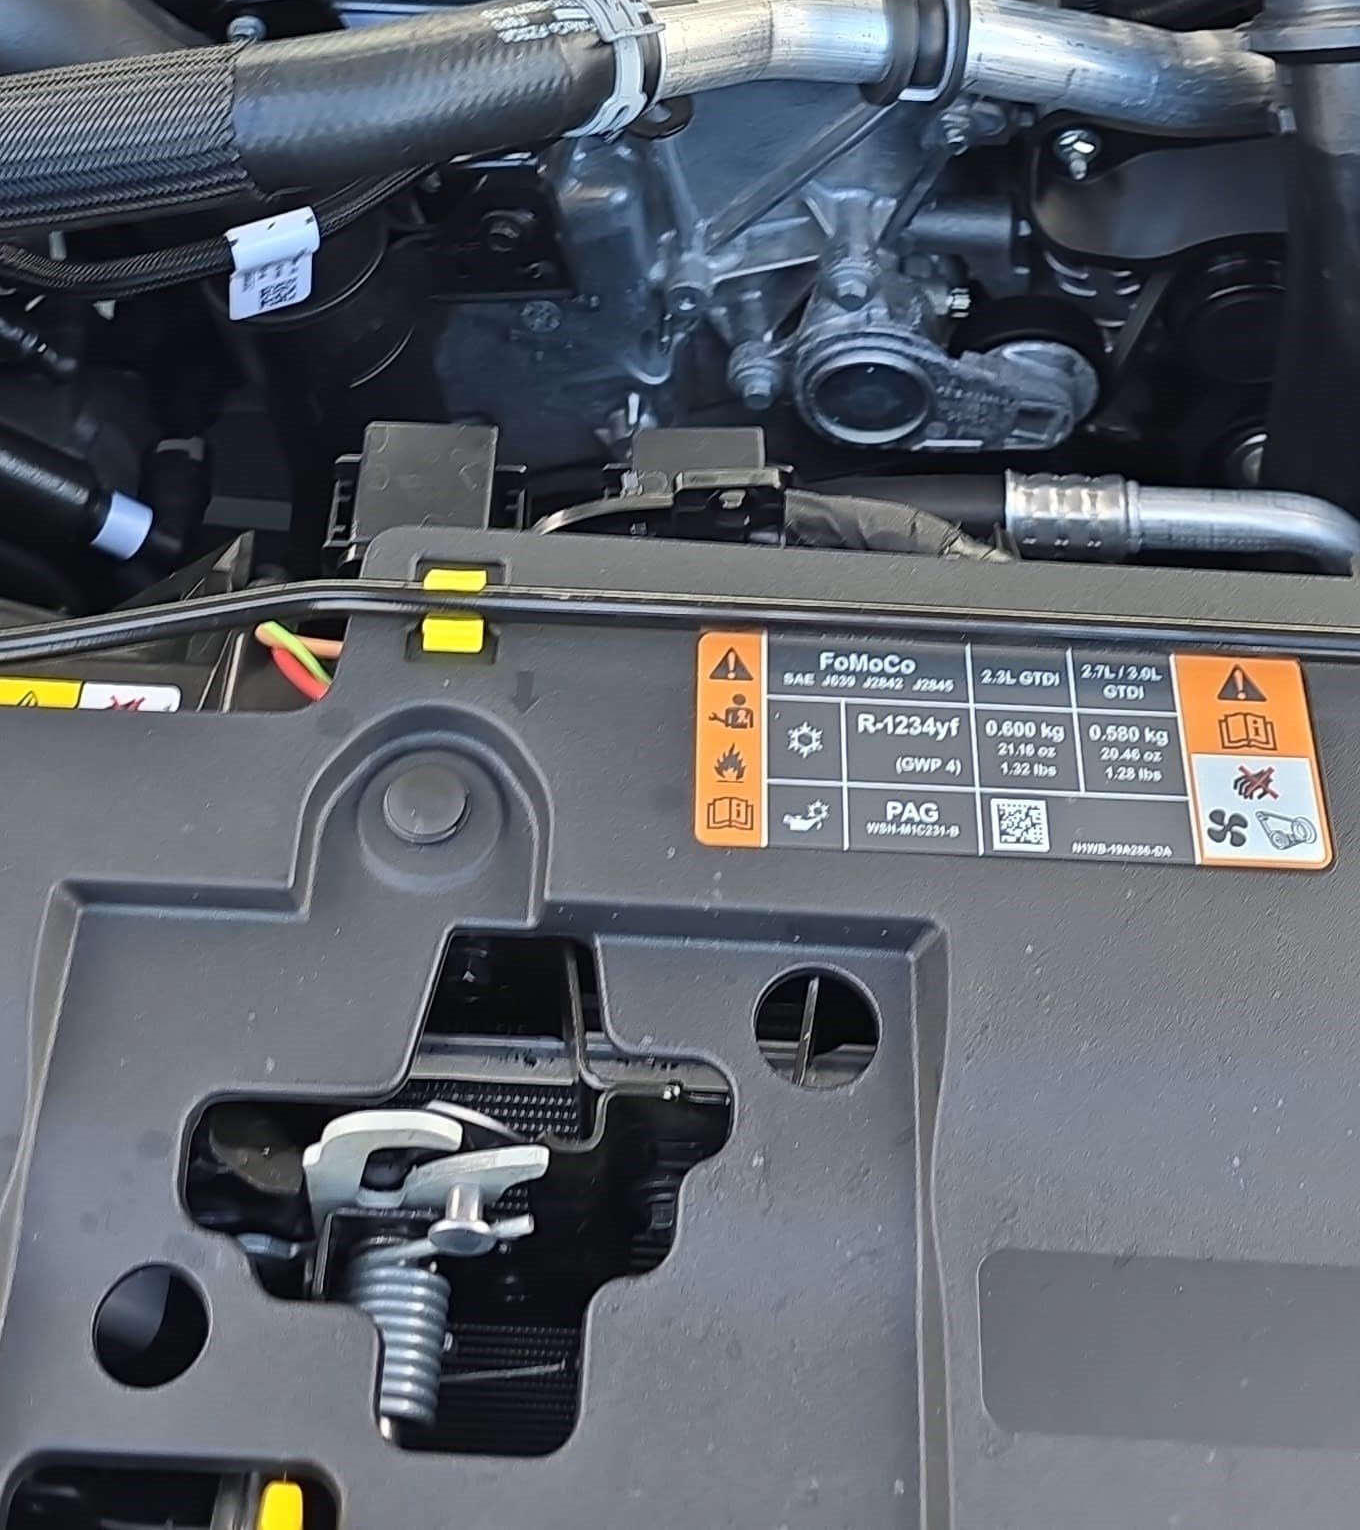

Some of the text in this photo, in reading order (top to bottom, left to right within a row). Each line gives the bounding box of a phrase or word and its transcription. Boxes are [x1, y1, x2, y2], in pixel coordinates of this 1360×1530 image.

[819, 651, 917, 674] FoMoCo
[979, 668, 1061, 687] 2.3L GTDI
[1080, 663, 1117, 681] 2.7L
[783, 673, 816, 687] SAE
[821, 674, 856, 689] J639
[862, 675, 905, 691] J2842
[1103, 684, 1145, 700] GTDI
[856, 712, 961, 742] R-1234yf
[985, 719, 1065, 743] 0.600 kg
[1088, 723, 1169, 747] 0.580 kg
[996, 741, 1057, 759] 21.16 oz
[1142, 750, 1163, 763] oz
[895, 756, 962, 777] (GWP 4)
[999, 761, 1057, 778] 1.32 lbs
[1104, 765, 1163, 782] 1.28 lbs
[886, 800, 940, 823] PAG
